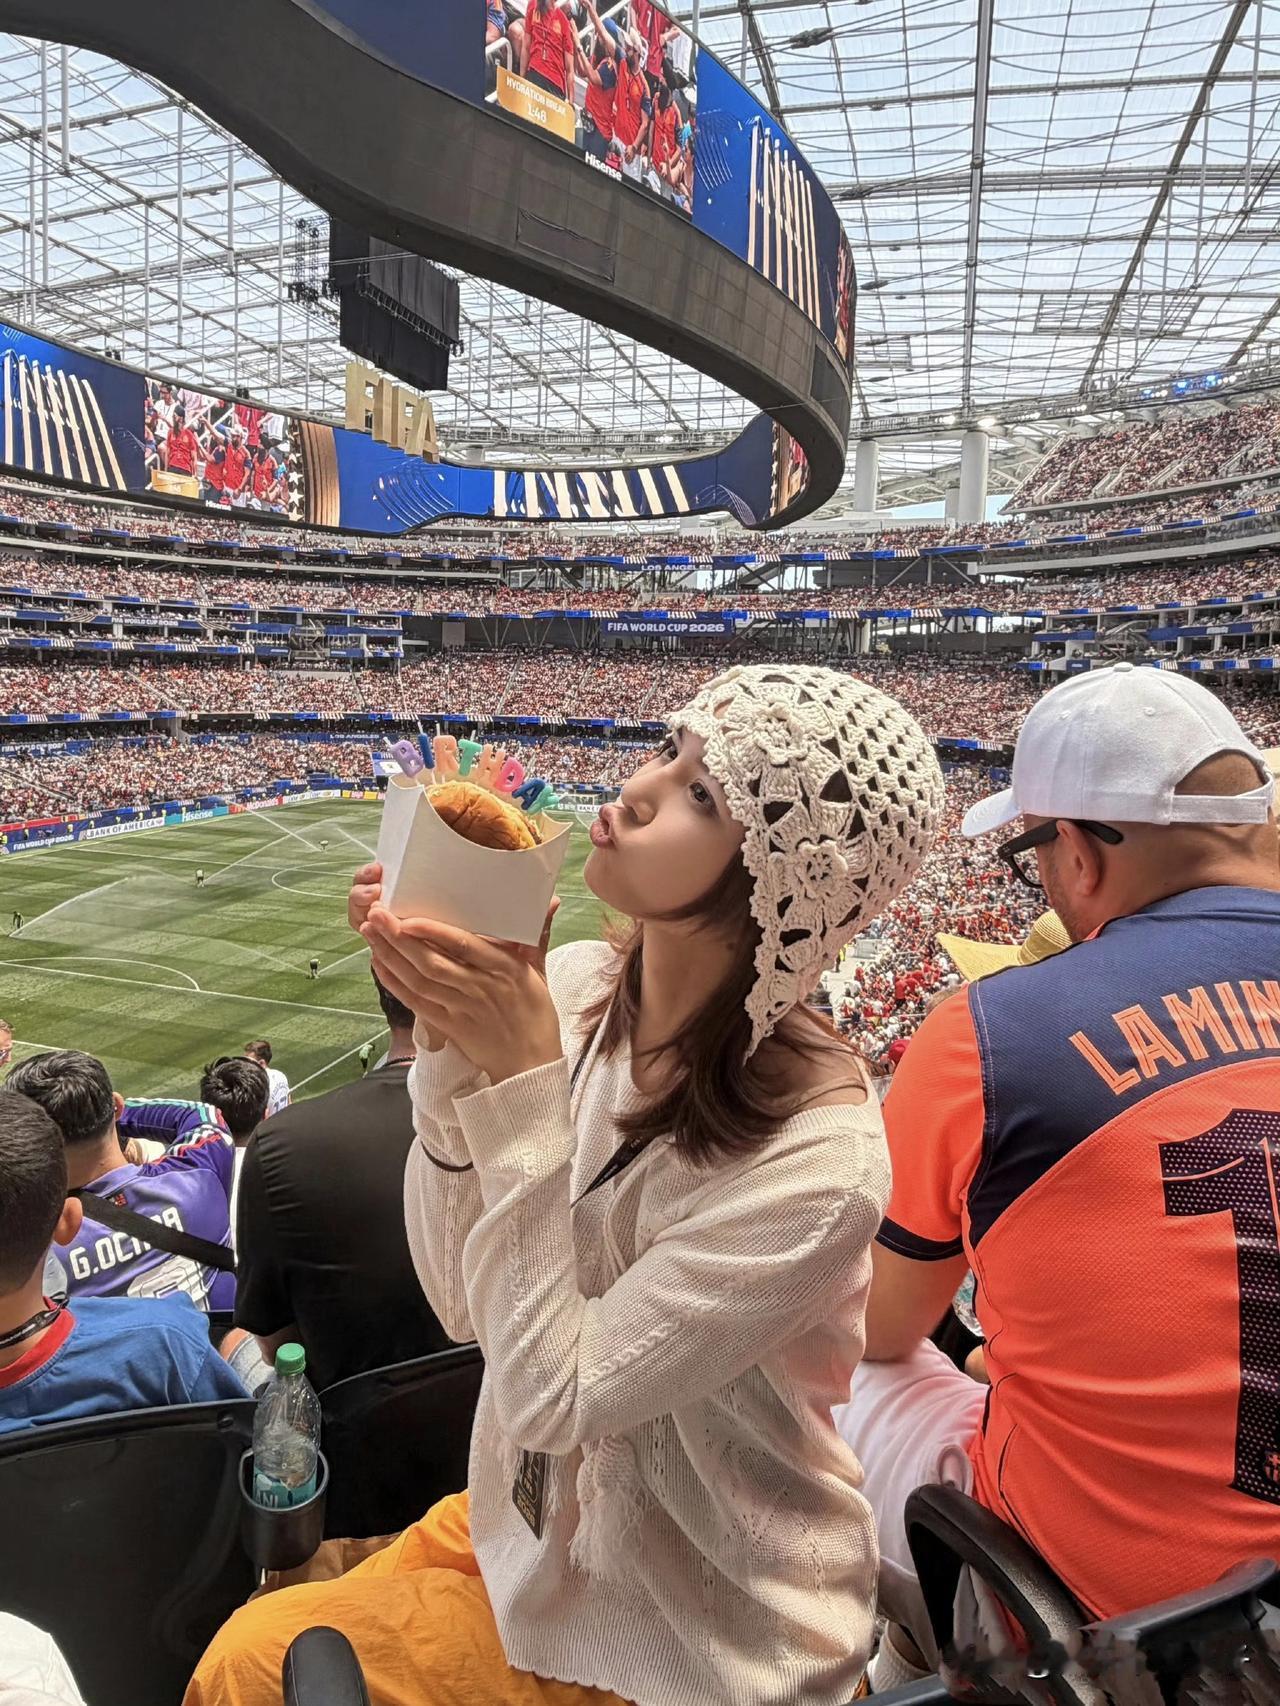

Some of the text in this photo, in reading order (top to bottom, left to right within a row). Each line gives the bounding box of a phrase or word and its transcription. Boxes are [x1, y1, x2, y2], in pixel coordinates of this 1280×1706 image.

[506, 76, 546, 106] HYDRATION
[585, 151, 622, 181] Hisense
[344, 362, 440, 464] FIFA
[664, 564, 713, 572] ANGELES
[607, 622, 725, 632] FIFA WORLD CUP 2026
[184, 810, 214, 822] Hisense
[90, 820, 156, 837] BANK OF AMERICA
[13, 842, 25, 851] FIFA
[25, 840, 45, 849] WORLD
